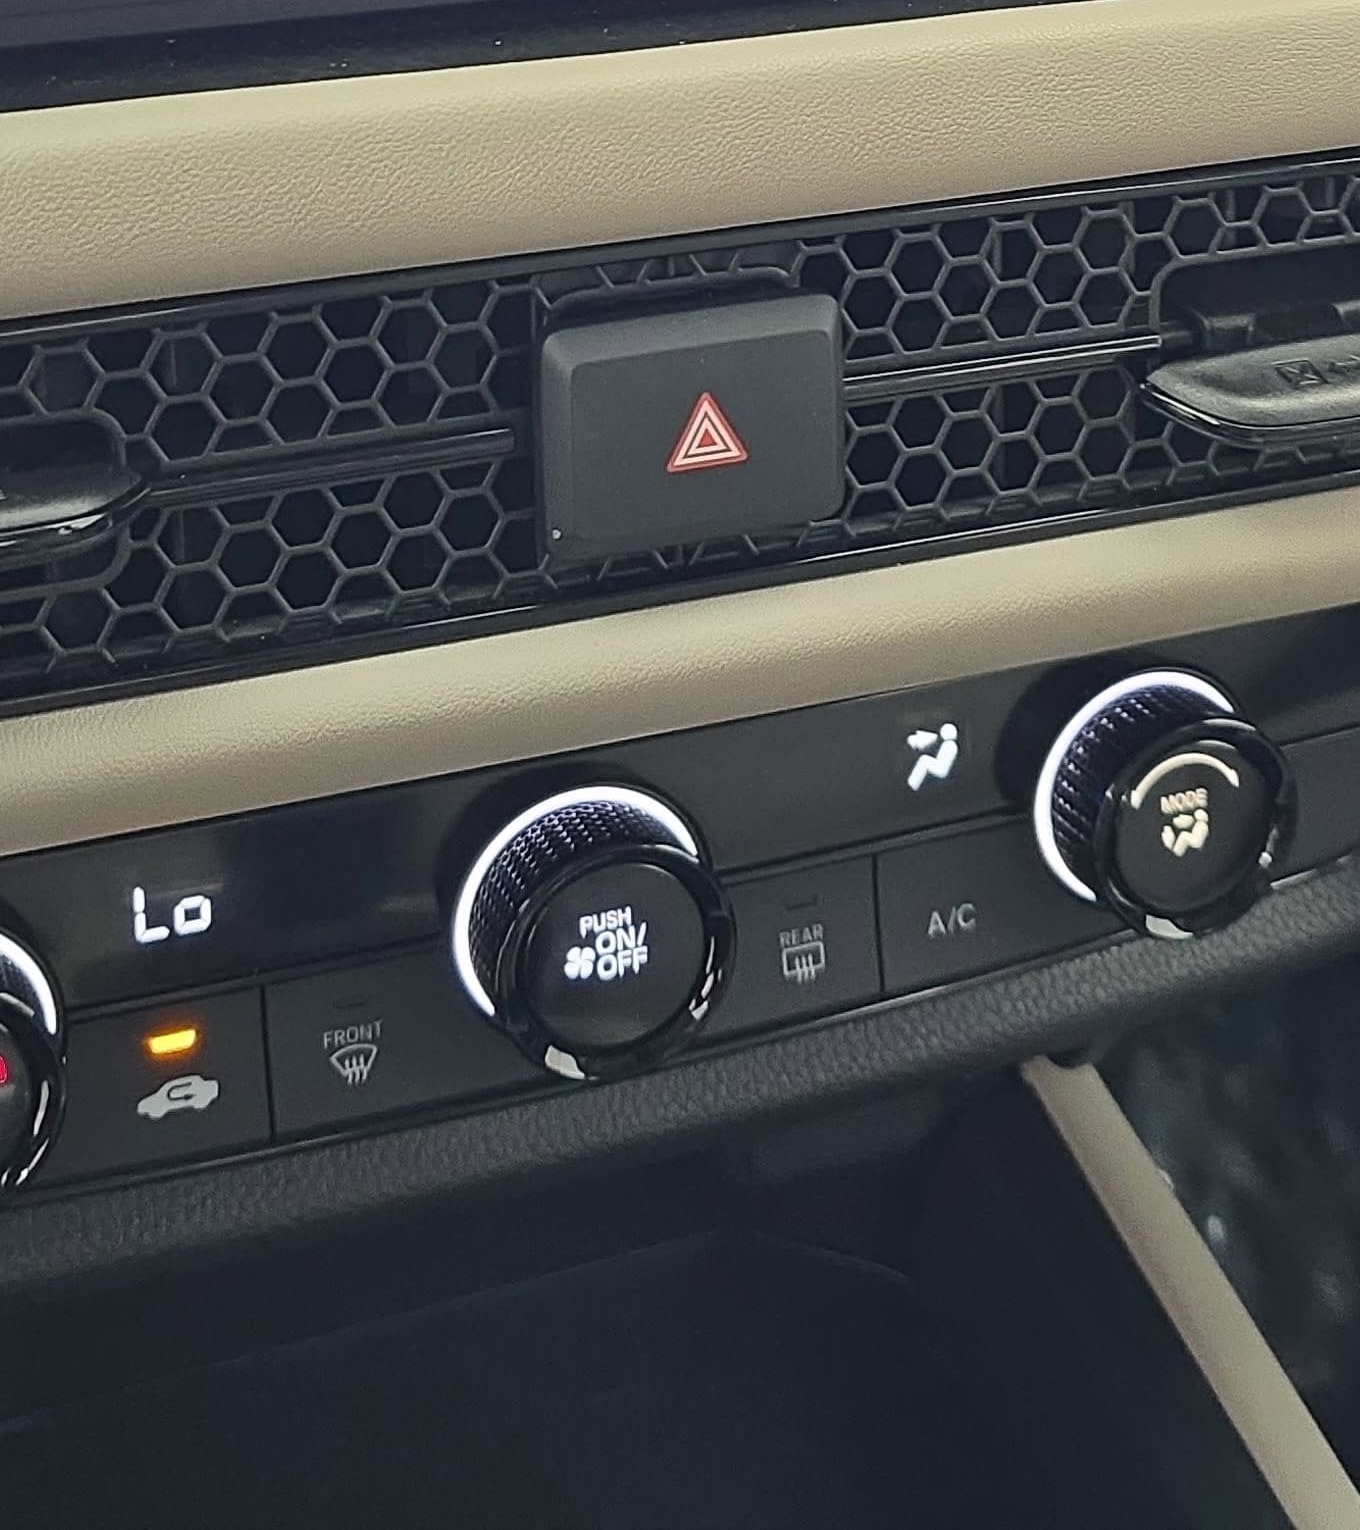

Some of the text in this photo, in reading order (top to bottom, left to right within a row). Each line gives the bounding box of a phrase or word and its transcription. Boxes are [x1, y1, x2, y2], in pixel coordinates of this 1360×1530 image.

[1160, 788, 1208, 814] MODE
[579, 906, 632, 938] PUSH
[780, 924, 824, 947] REAR
[927, 903, 976, 938] A/C
[597, 945, 648, 980] OFF
[323, 1020, 383, 1049] FRONT
